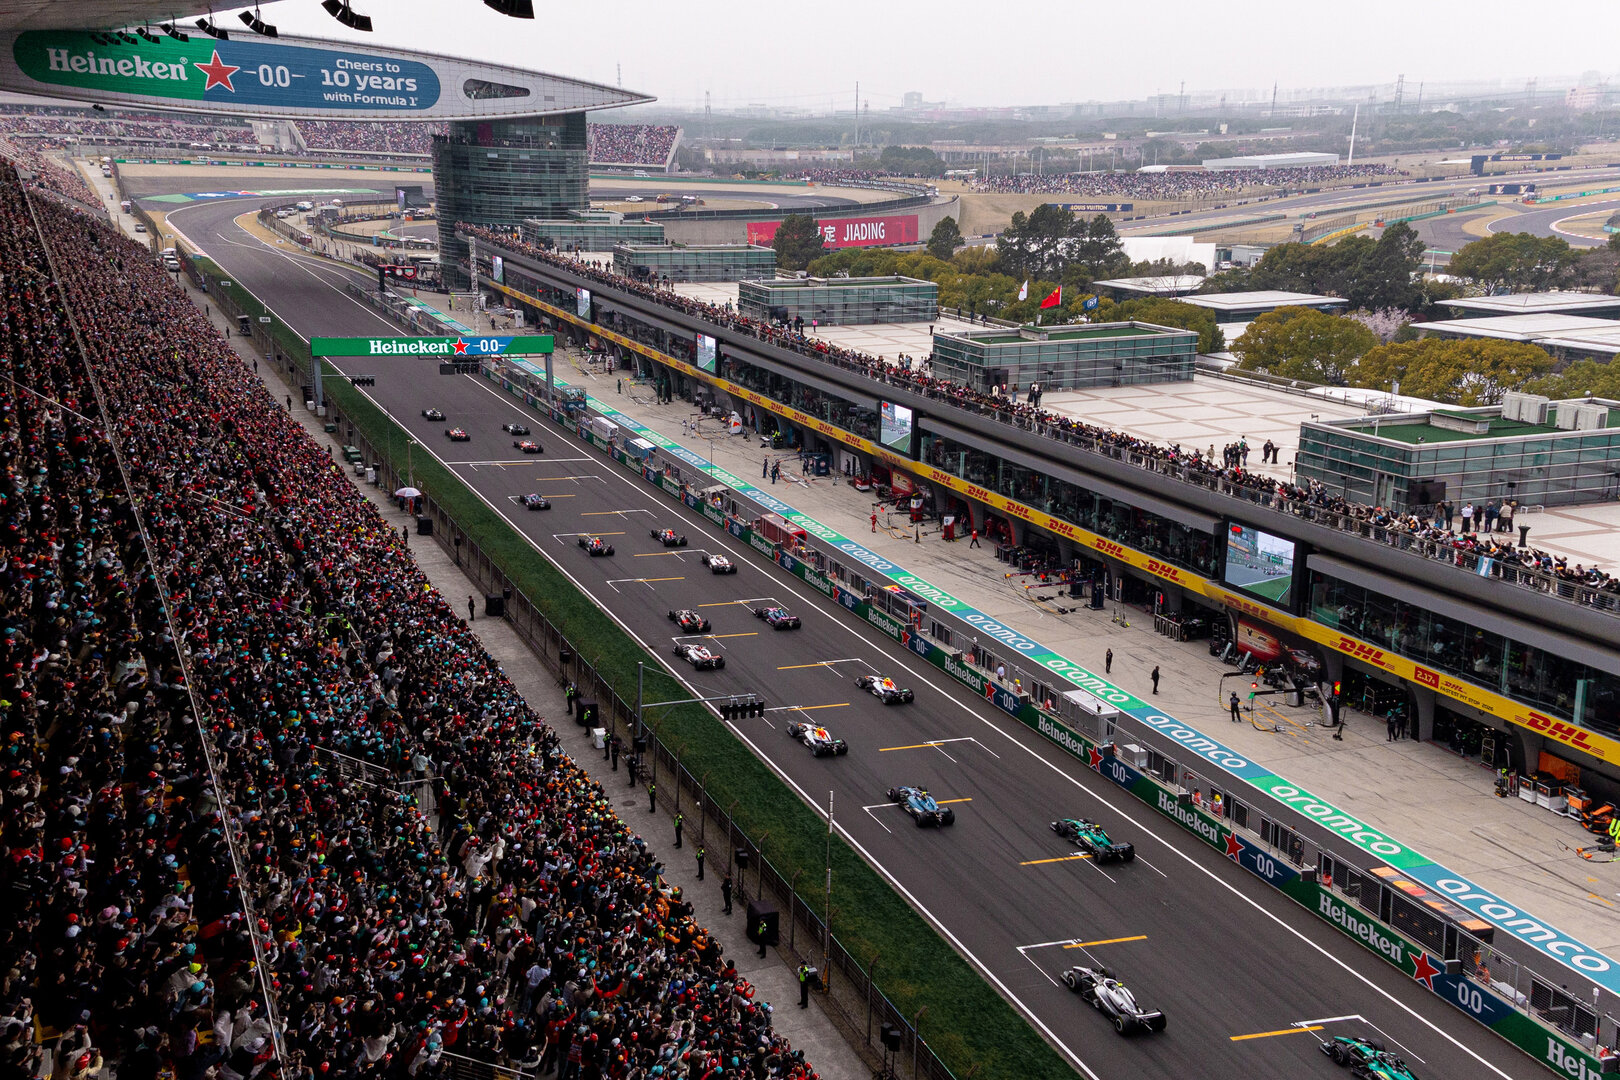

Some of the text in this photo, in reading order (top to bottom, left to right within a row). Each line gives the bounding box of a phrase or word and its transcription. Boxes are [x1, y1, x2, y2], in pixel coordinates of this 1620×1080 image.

[46, 48, 188, 81] Heineken
[336, 58, 400, 73] Cheers to
[320, 69, 418, 92] 10 years
[323, 92, 352, 103] with
[353, 93, 407, 106] Formula
[843, 222, 886, 242] JIADING
[369, 340, 450, 354] Heineken
[770, 402, 785, 415] DHL
[793, 412, 808, 426] DHL
[818, 423, 834, 436] DHL
[845, 434, 861, 448] DHL
[707, 468, 745, 487] aramco
[932, 470, 953, 486] DHL
[746, 490, 788, 511] aramco
[967, 485, 989, 502] DHL
[1006, 501, 1030, 520] DHL
[791, 515, 837, 539] aramco
[1049, 518, 1076, 538] DHL
[840, 543, 893, 570] aramco
[1095, 537, 1125, 559] DHL
[1147, 560, 1180, 582] DHL
[898, 575, 958, 607] aramco
[868, 608, 899, 638] Heineken
[965, 613, 1036, 651] aramco
[1338, 636, 1390, 668] DHL
[944, 655, 981, 691] Heineken
[1046, 659, 1130, 703] aramco
[1440, 686, 1459, 698] FASTEST
[1468, 697, 1480, 706] STOP
[1038, 714, 1084, 757] Heineken
[1145, 715, 1247, 768] aramco
[1526, 712, 1596, 750] DHL
[1157, 790, 1219, 843] Heineken
[1270, 785, 1402, 855] aramco
[1319, 892, 1404, 963] Heineken
[1435, 879, 1611, 972] aramco
